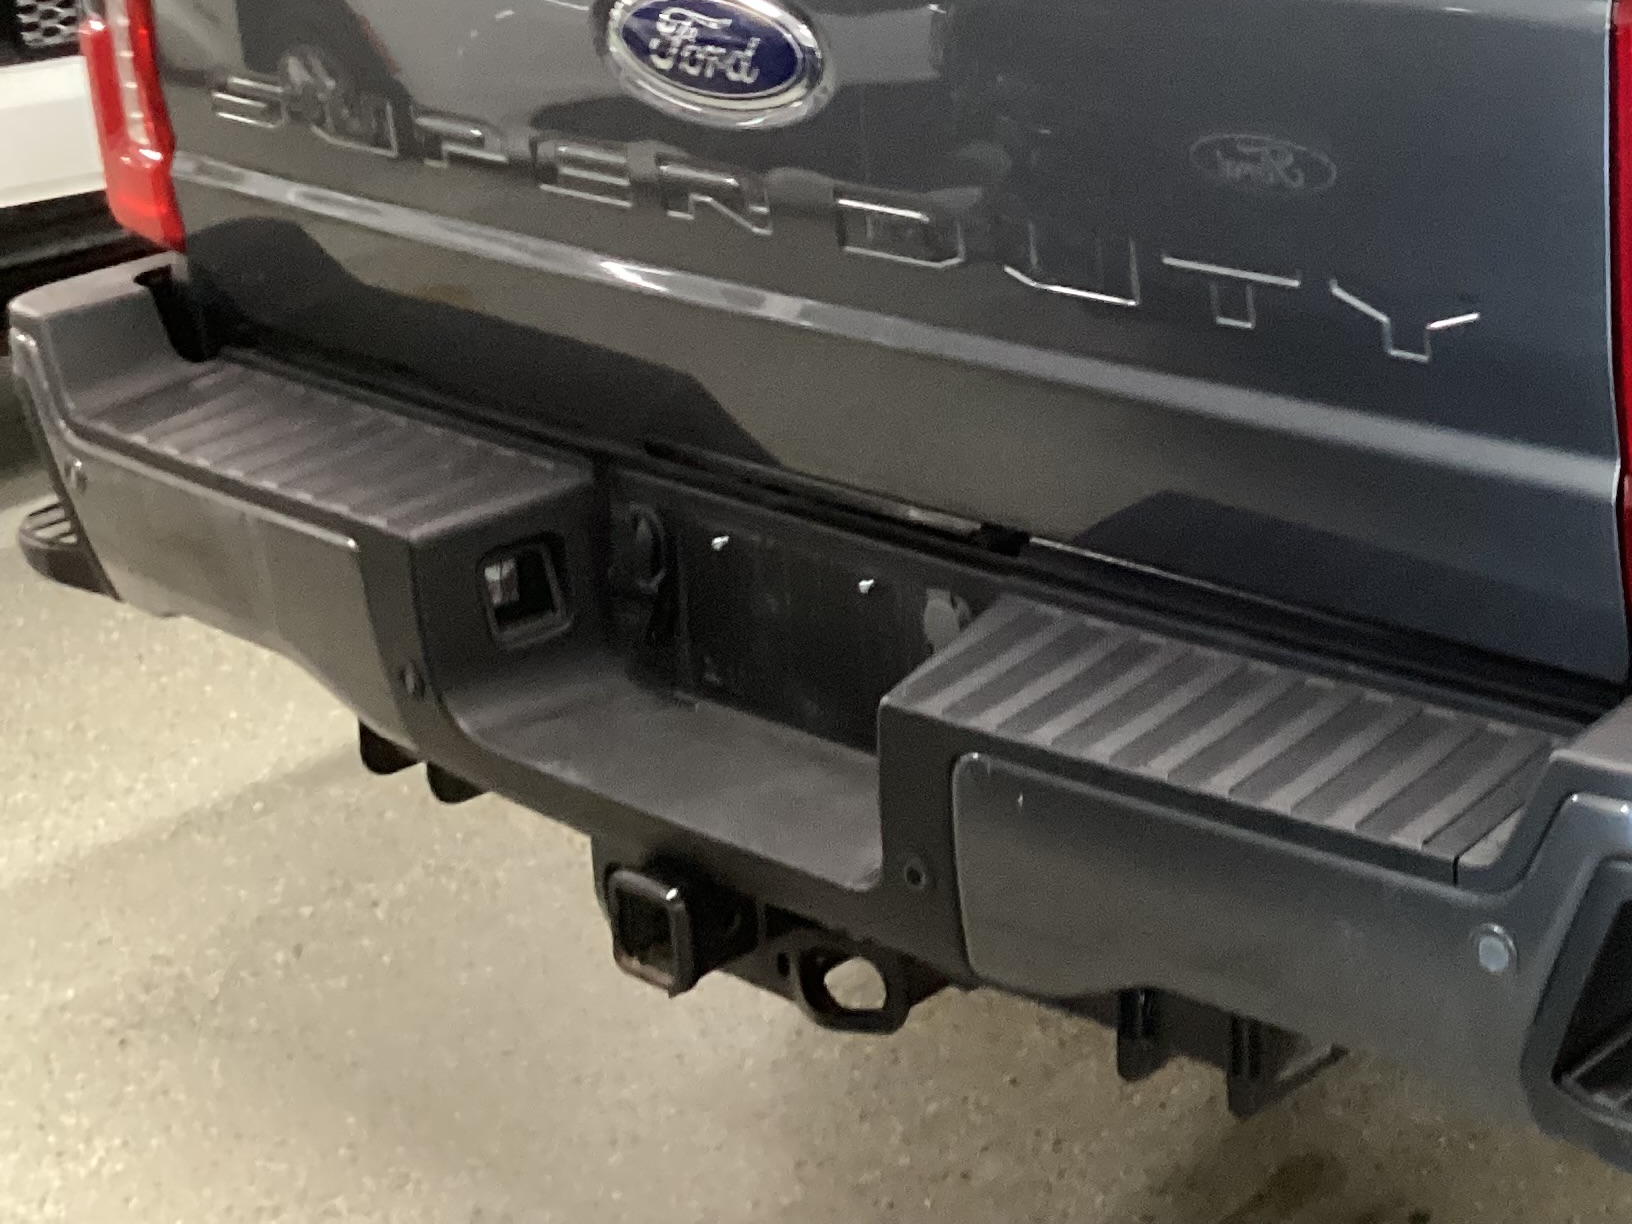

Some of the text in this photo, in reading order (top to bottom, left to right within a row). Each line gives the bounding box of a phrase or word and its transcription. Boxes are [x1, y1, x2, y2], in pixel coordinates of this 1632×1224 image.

[649, 6, 761, 84] Ford
[209, 74, 1481, 364] SUPER DUTY
